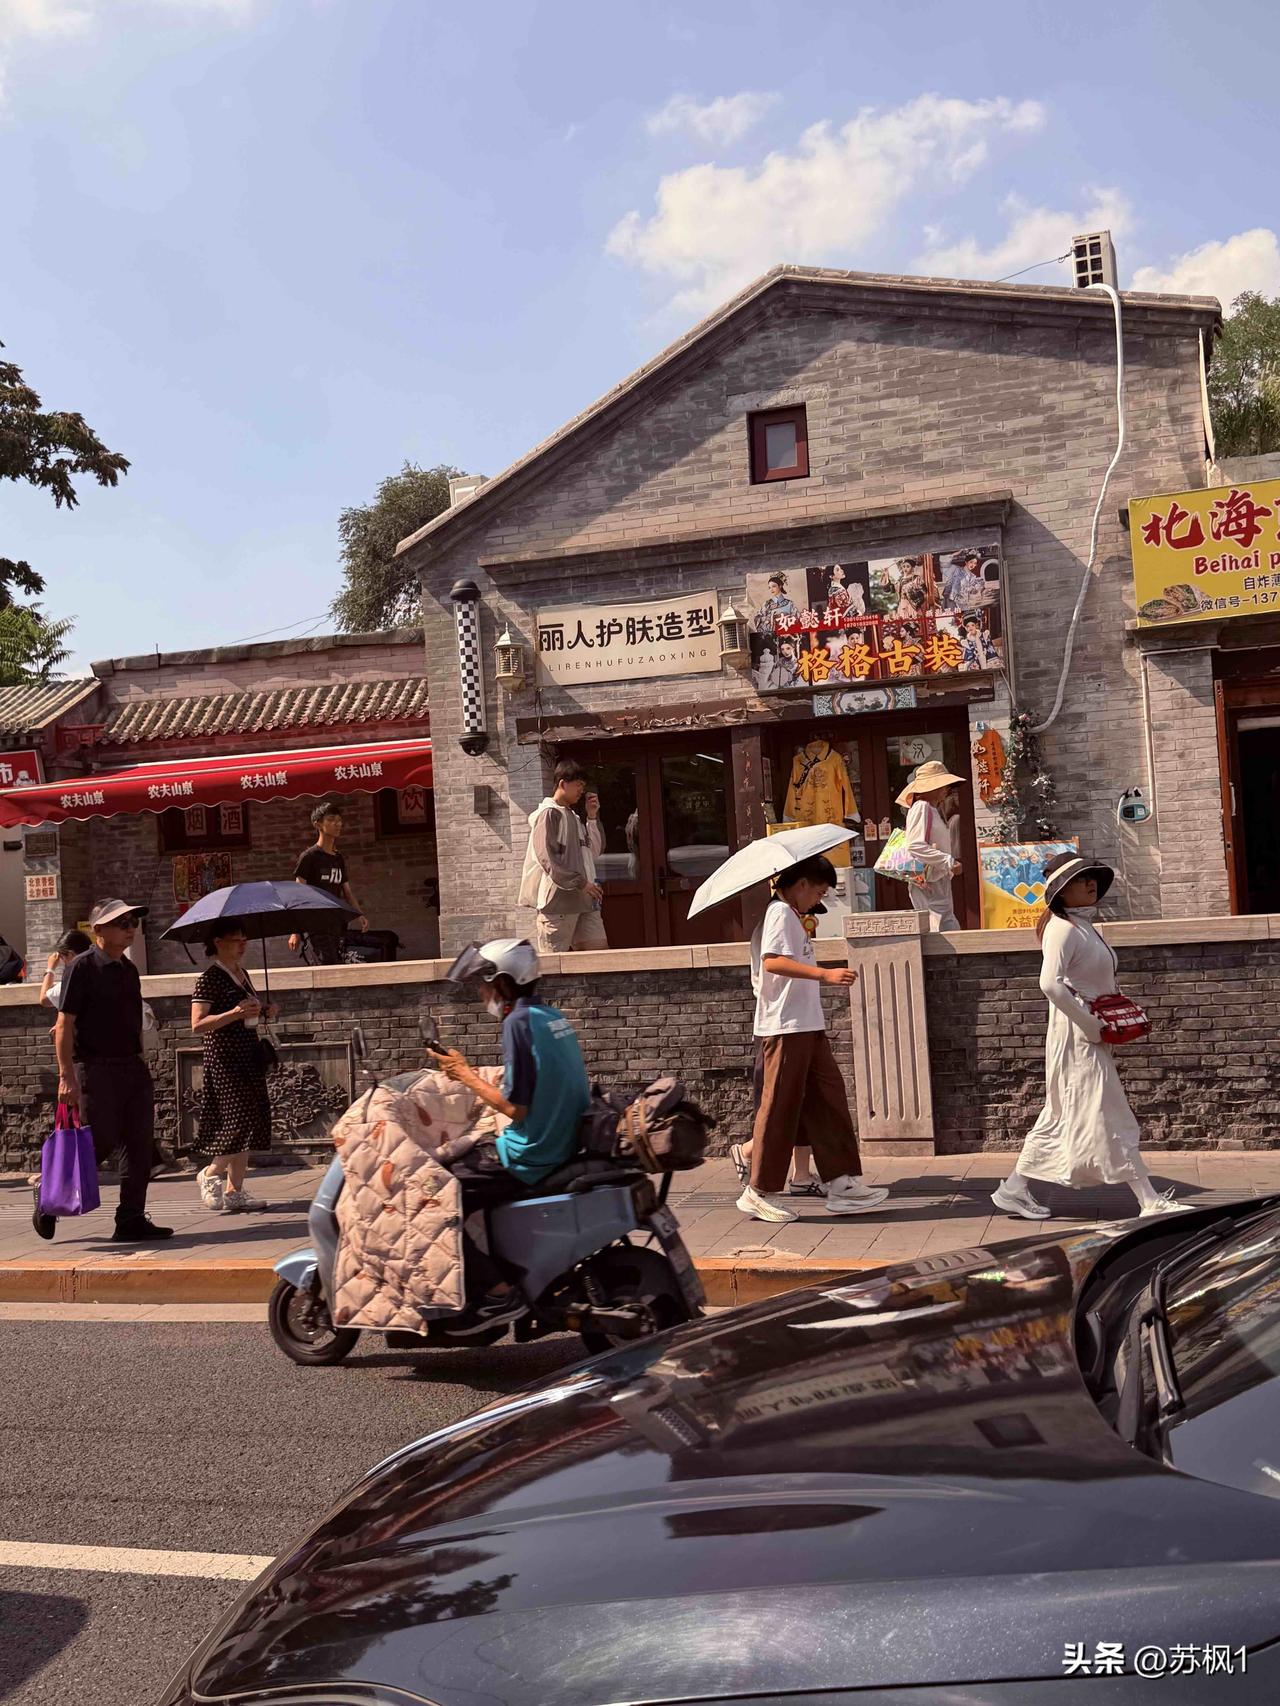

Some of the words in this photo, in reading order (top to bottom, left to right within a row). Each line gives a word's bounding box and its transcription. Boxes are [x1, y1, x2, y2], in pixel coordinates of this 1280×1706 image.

[1141, 489, 1280, 550] 北海
[1194, 550, 1259, 575] Beihai
[538, 606, 716, 652] 丽人护肤造型
[775, 607, 843, 632] 如懿轩
[548, 649, 708, 672] LIRENHUFUZAOXING
[796, 634, 964, 683] 格格古装
[240, 770, 287, 791] 农夫山泉
[334, 761, 383, 782] 农夫山泉
[60, 789, 104, 809] 农夫山泉
[147, 779, 194, 800] 农夫山泉
[222, 805, 241, 831] 酒
